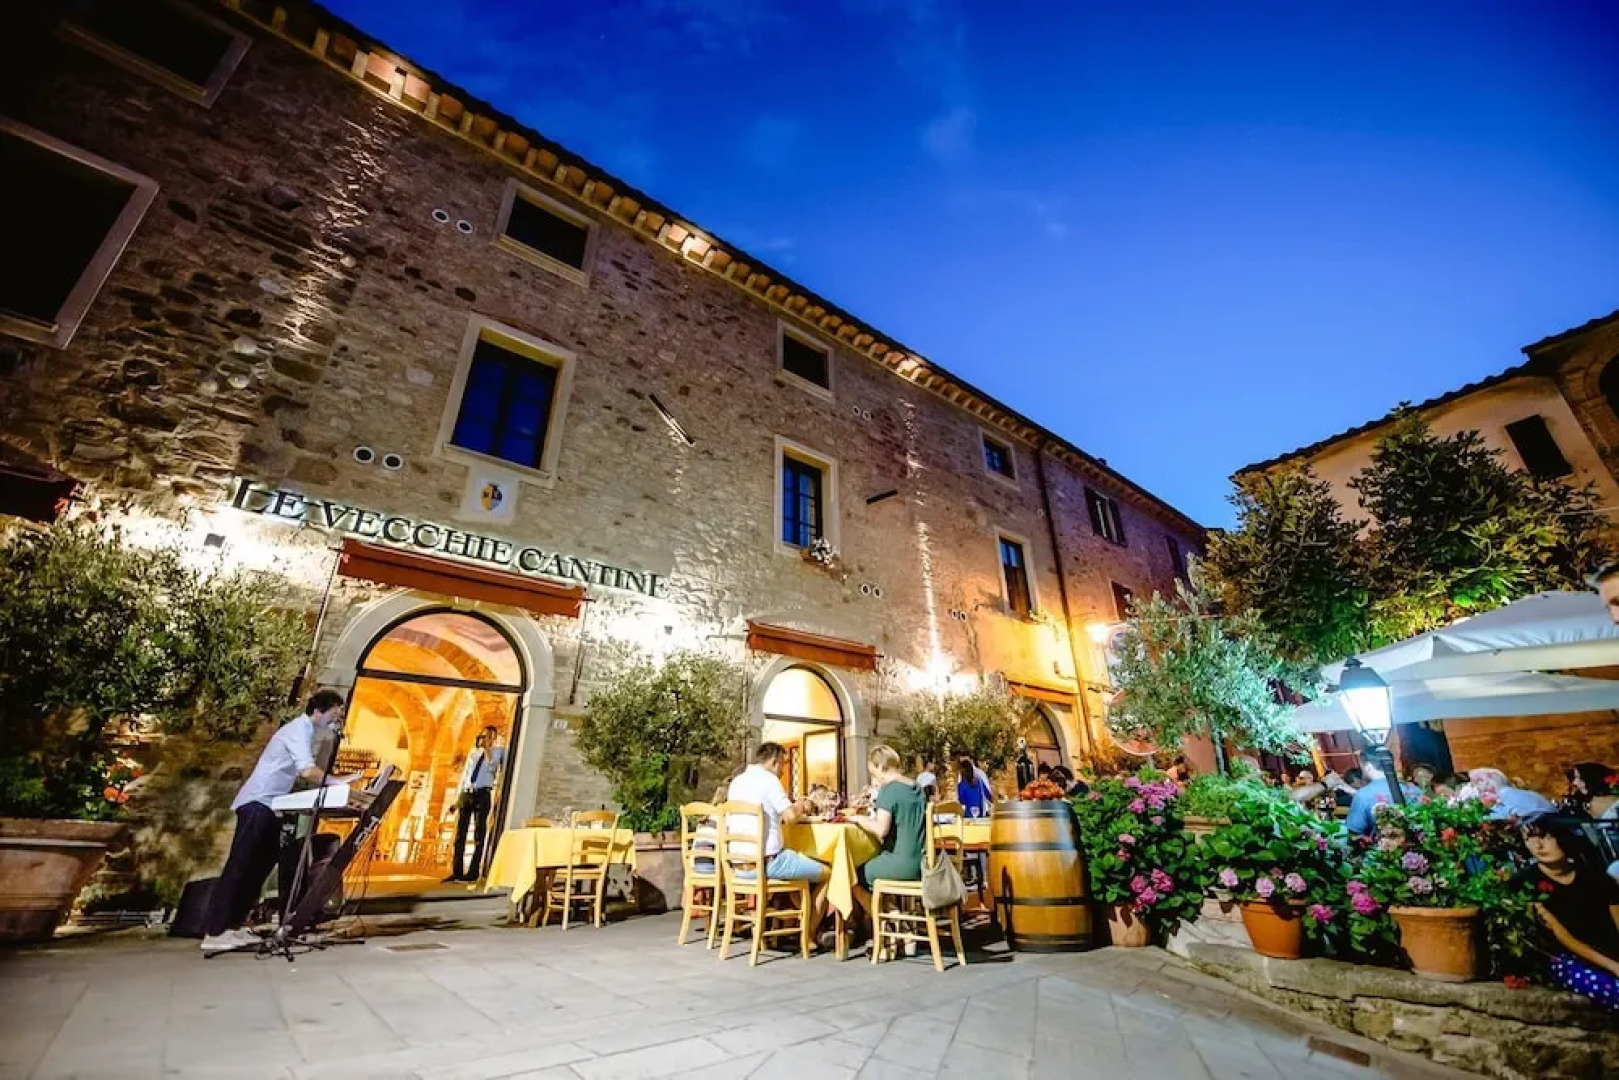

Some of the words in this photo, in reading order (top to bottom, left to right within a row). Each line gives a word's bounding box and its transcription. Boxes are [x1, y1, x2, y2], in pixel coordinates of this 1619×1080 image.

[232, 477, 306, 521] LE
[308, 500, 512, 565] VECCHIE
[518, 547, 668, 598] CANTINE
